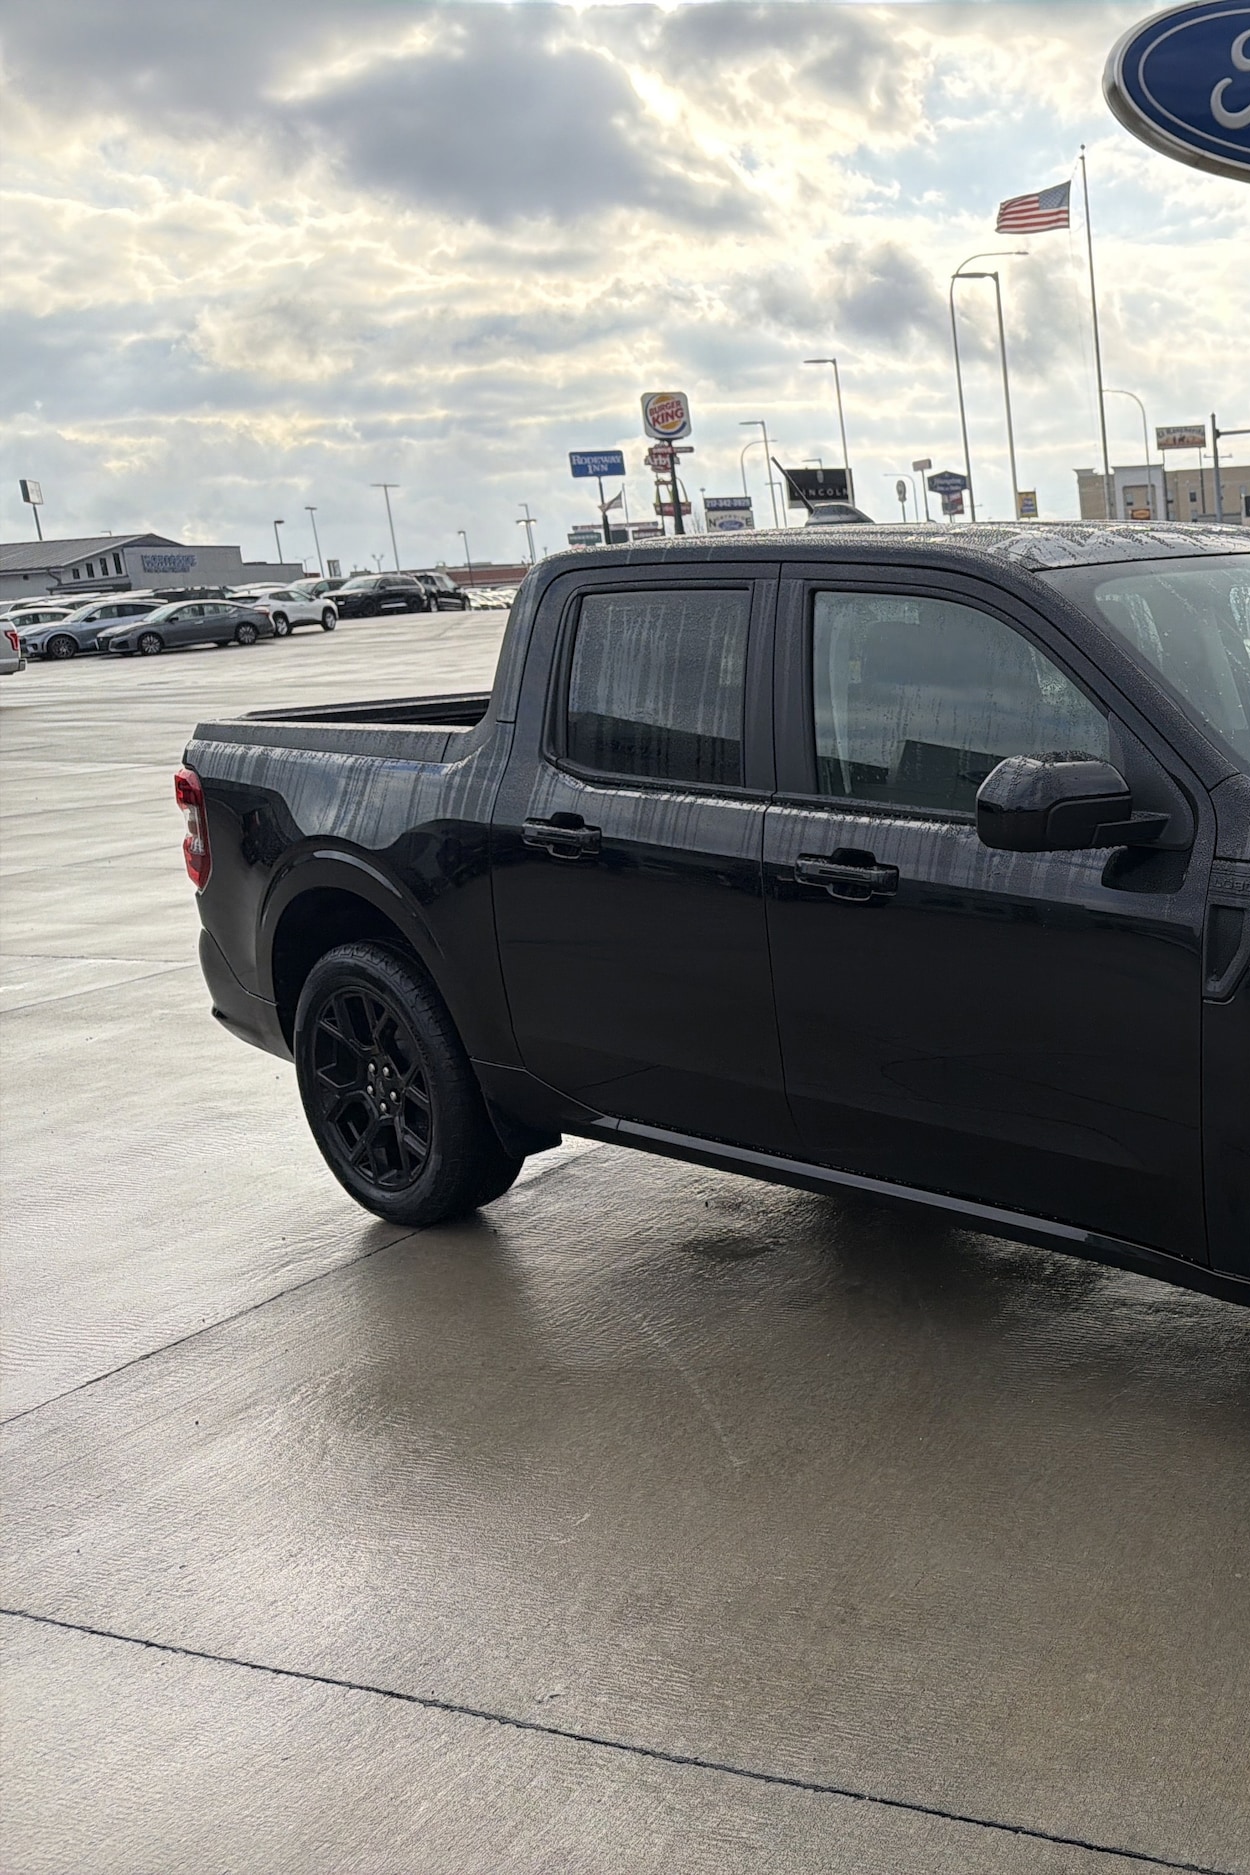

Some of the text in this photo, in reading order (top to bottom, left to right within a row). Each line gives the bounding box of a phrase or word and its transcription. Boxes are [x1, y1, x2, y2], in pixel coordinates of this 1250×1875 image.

[649, 400, 682, 416] BURGER
[652, 408, 684, 427] KING
[588, 464, 608, 474] INN
